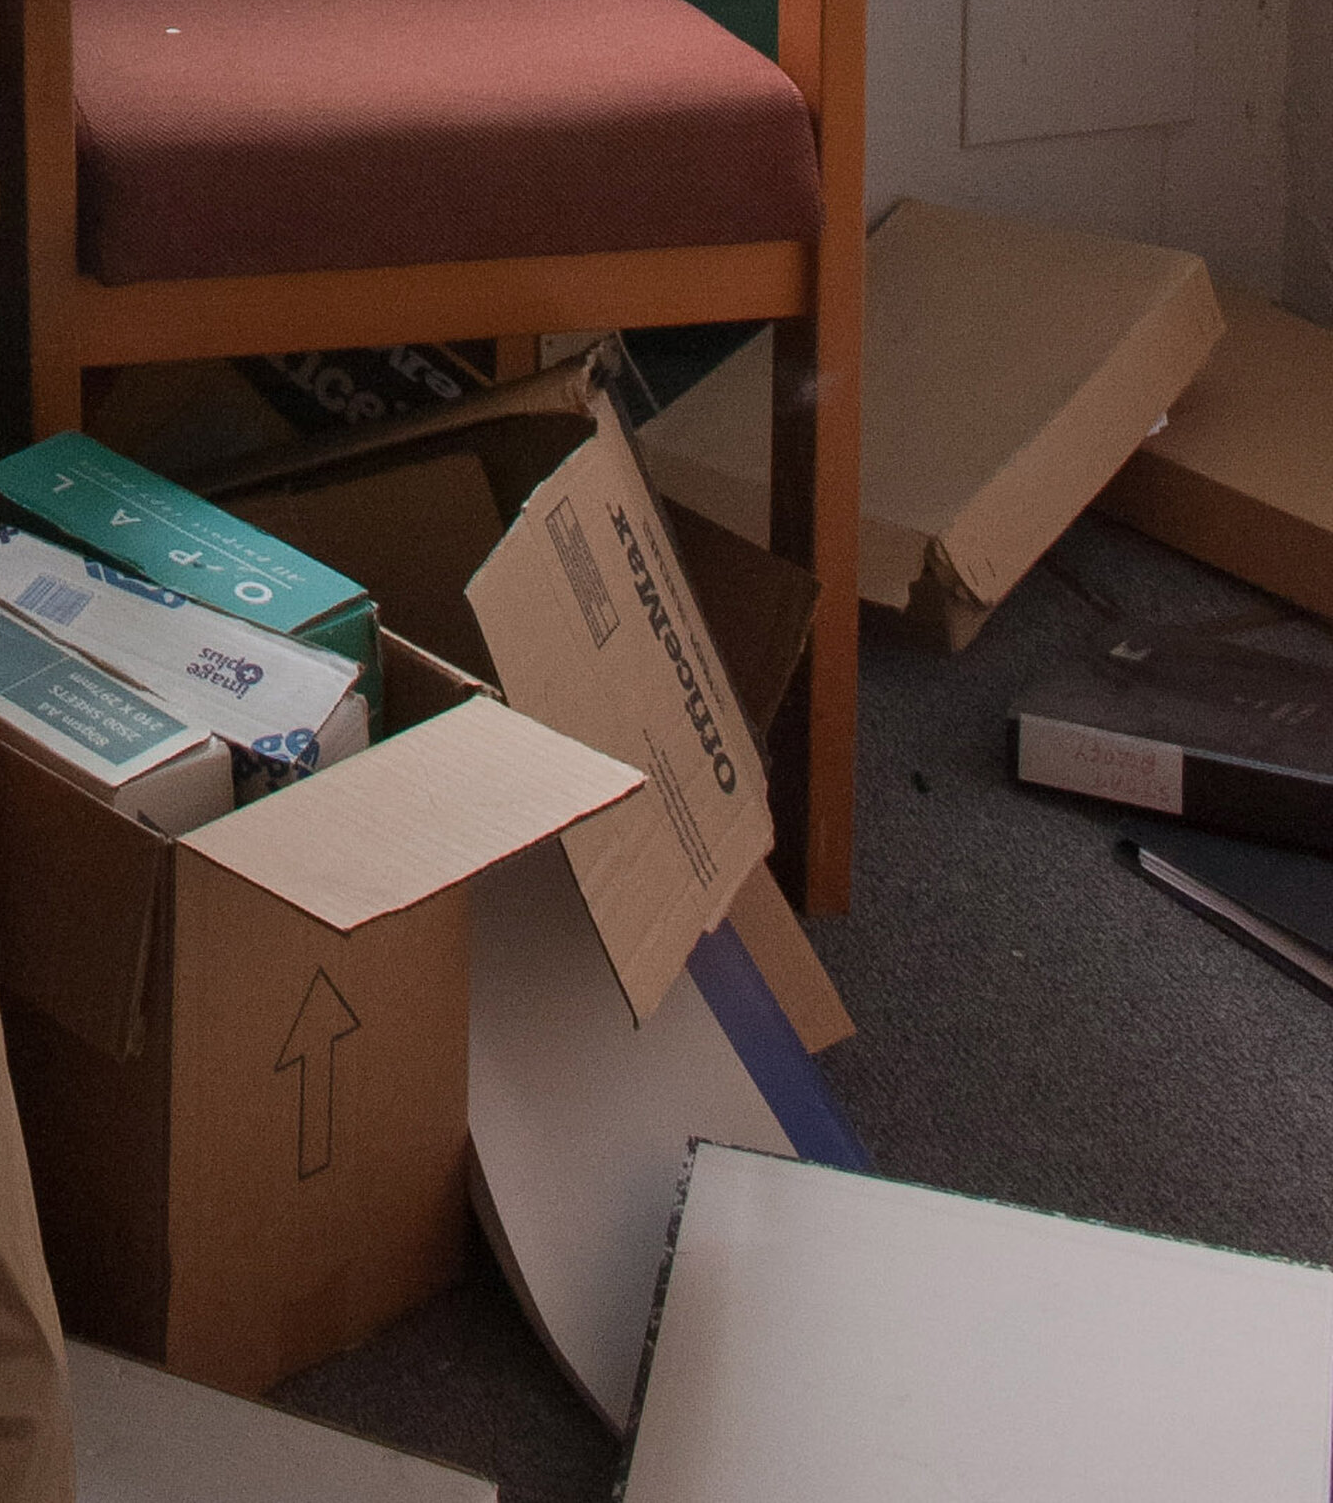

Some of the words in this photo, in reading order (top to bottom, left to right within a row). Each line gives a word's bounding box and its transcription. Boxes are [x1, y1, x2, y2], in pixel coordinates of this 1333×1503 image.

[198, 646, 245, 674] plus
[608, 503, 737, 795] OfficeMax
[186, 662, 250, 700] image
[48, 684, 103, 719] SHEETS
[103, 716, 141, 742] 2500
[133, 710, 164, 731] 210
